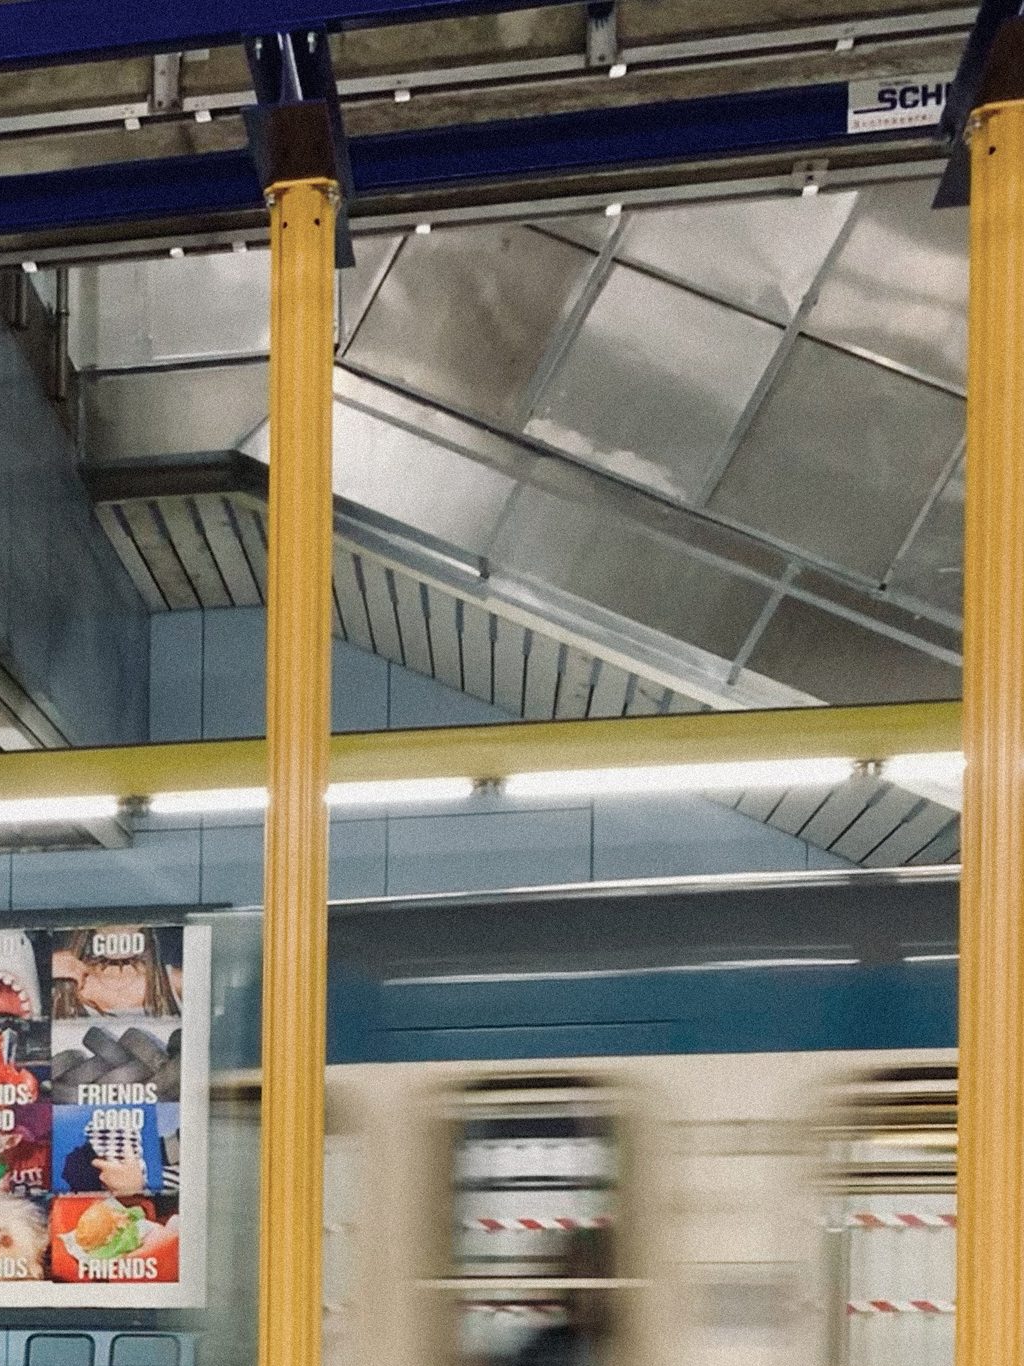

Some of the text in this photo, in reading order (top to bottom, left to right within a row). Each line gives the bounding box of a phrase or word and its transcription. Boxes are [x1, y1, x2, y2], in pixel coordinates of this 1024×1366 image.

[92, 932, 145, 955] GOOD
[78, 1083, 158, 1106] FRIENDS
[92, 1108, 145, 1130] GOOD
[78, 1257, 158, 1280] FRIENDS
